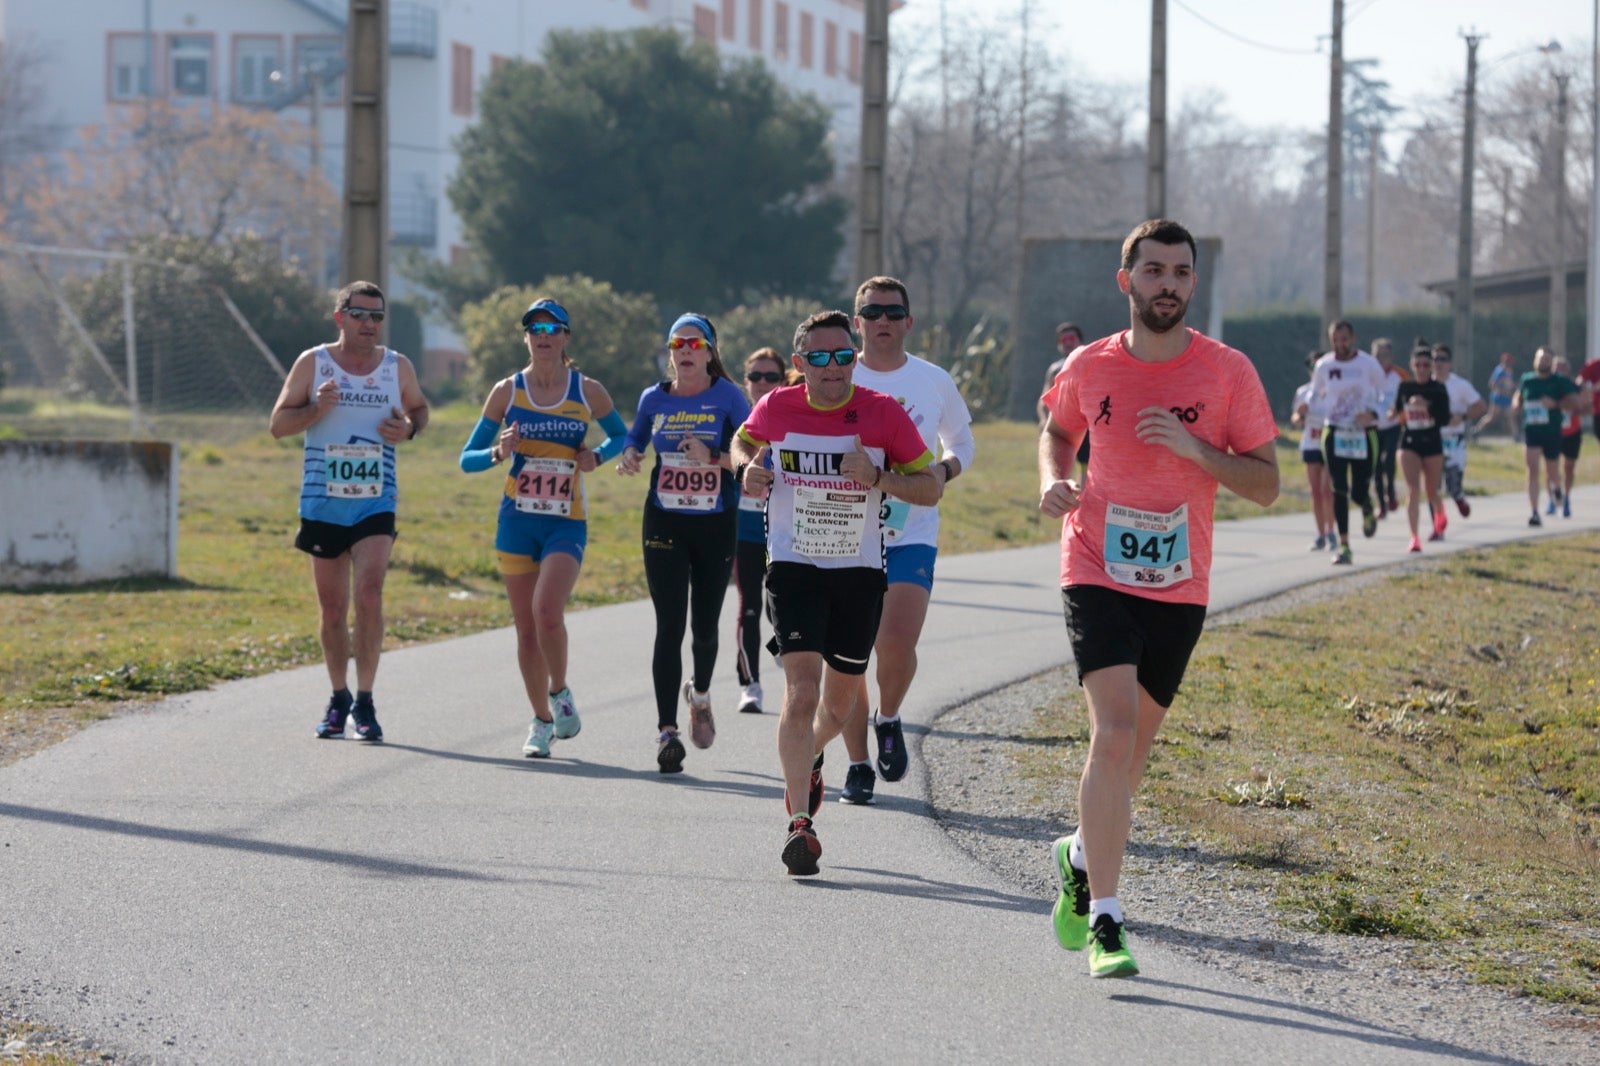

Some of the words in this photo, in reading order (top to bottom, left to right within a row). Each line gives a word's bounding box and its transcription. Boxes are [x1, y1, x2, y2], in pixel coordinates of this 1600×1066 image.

[339, 391, 389, 405] ARACENA
[667, 411, 716, 425] olimpo
[328, 460, 380, 480] 1044
[519, 474, 571, 498] 2114
[661, 469, 718, 492] 2099
[805, 509, 831, 517] CORRO
[818, 518, 849, 526] CANCER
[803, 527, 831, 536] aecc
[1120, 532, 1177, 563] 947
